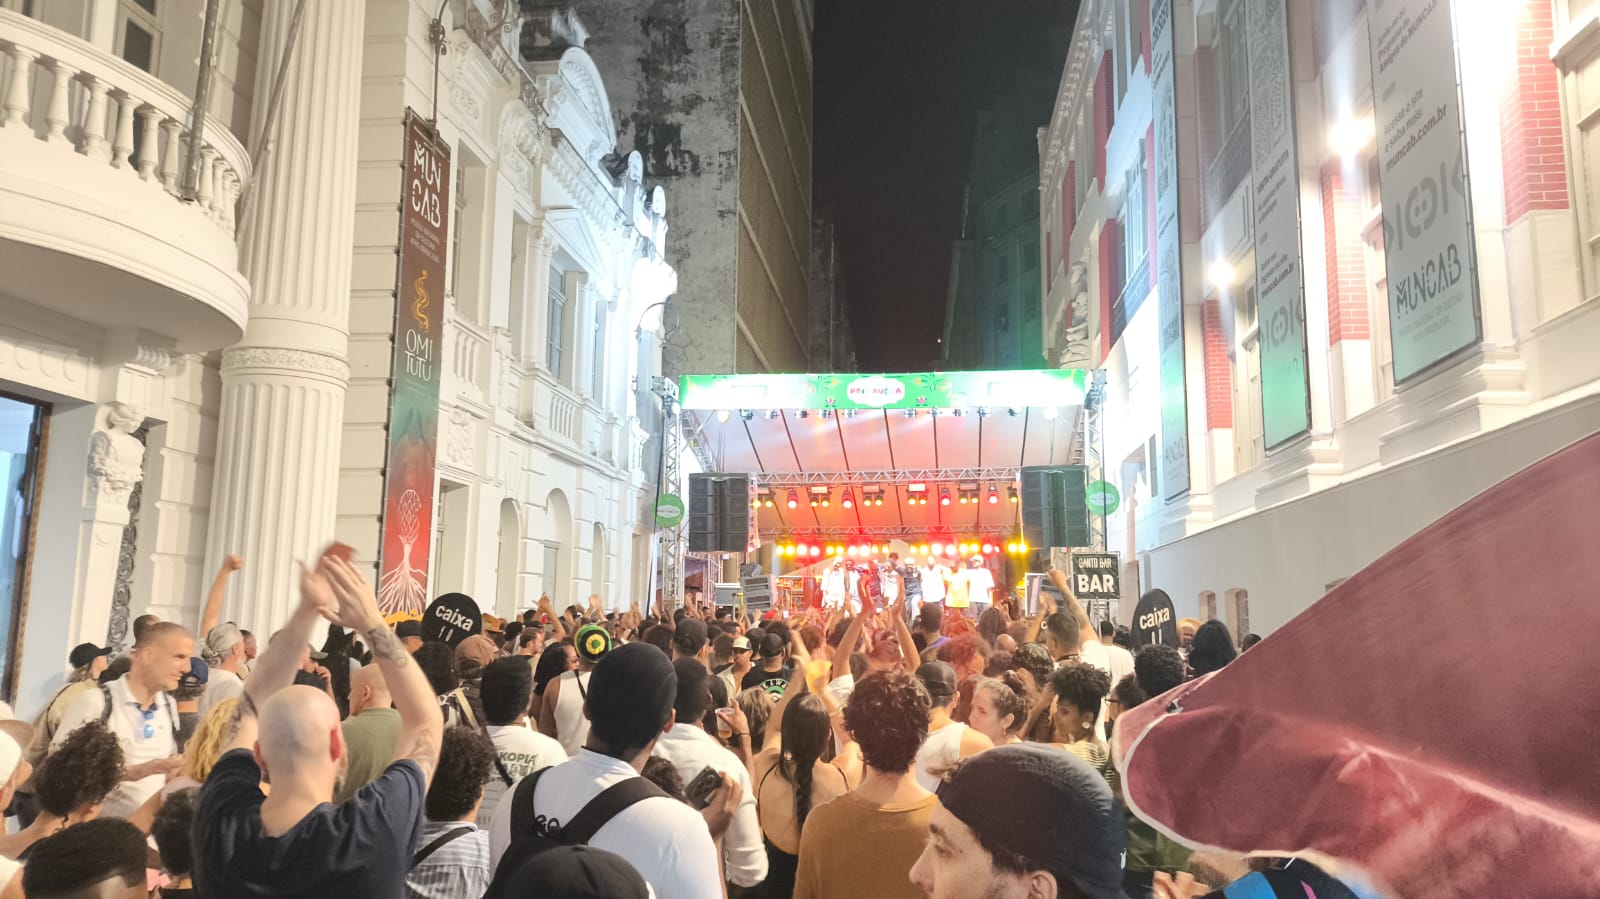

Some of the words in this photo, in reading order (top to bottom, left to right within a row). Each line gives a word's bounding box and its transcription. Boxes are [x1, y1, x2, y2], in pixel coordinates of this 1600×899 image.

[1386, 103, 1447, 174] muncab.com.br
[406, 329, 433, 361] OMI
[404, 350, 432, 382] TUTU
[1099, 557, 1112, 569] BAR
[1077, 574, 1115, 593] BAR
[435, 605, 474, 632] caixa
[1139, 606, 1170, 630] caixa
